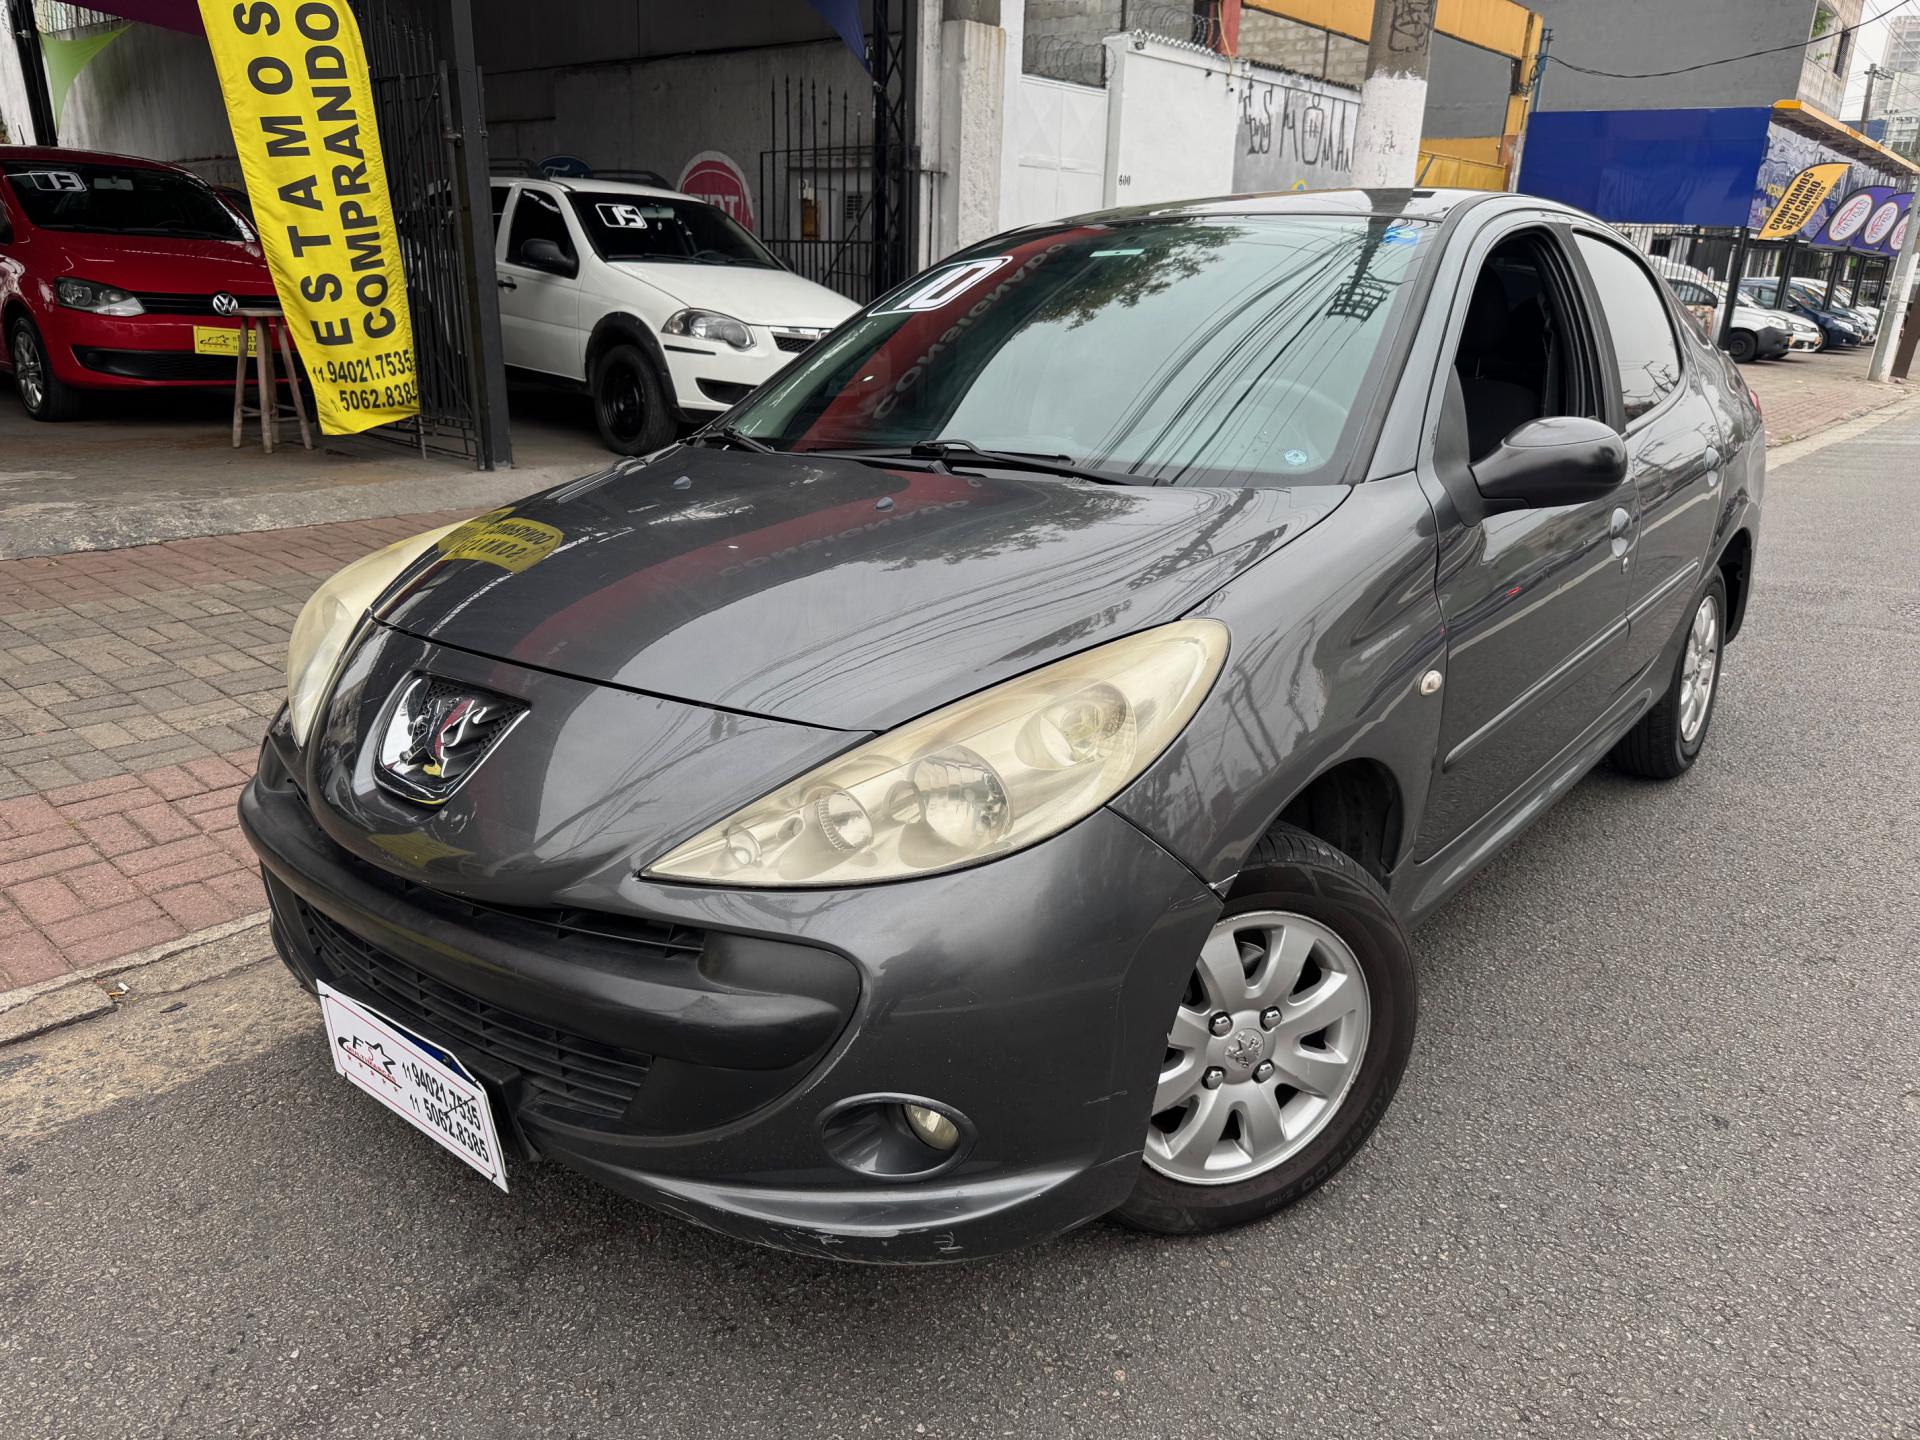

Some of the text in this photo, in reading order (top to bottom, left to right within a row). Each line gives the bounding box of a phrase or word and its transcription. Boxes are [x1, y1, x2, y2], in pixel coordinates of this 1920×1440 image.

[233, 1, 354, 346] ESTAMOS
[295, 2, 397, 338] COMPRANDO
[1768, 171, 1815, 231] COMPRAMOS
[1781, 212, 1800, 231] SEU
[1837, 199, 1871, 236] TREVISAN
[1869, 206, 1897, 241] TREVISAN
[326, 349, 414, 384] 94021.7535
[402, 1062, 482, 1132] 11 94021.7535
[409, 1093, 490, 1164] 11 5062.8385
